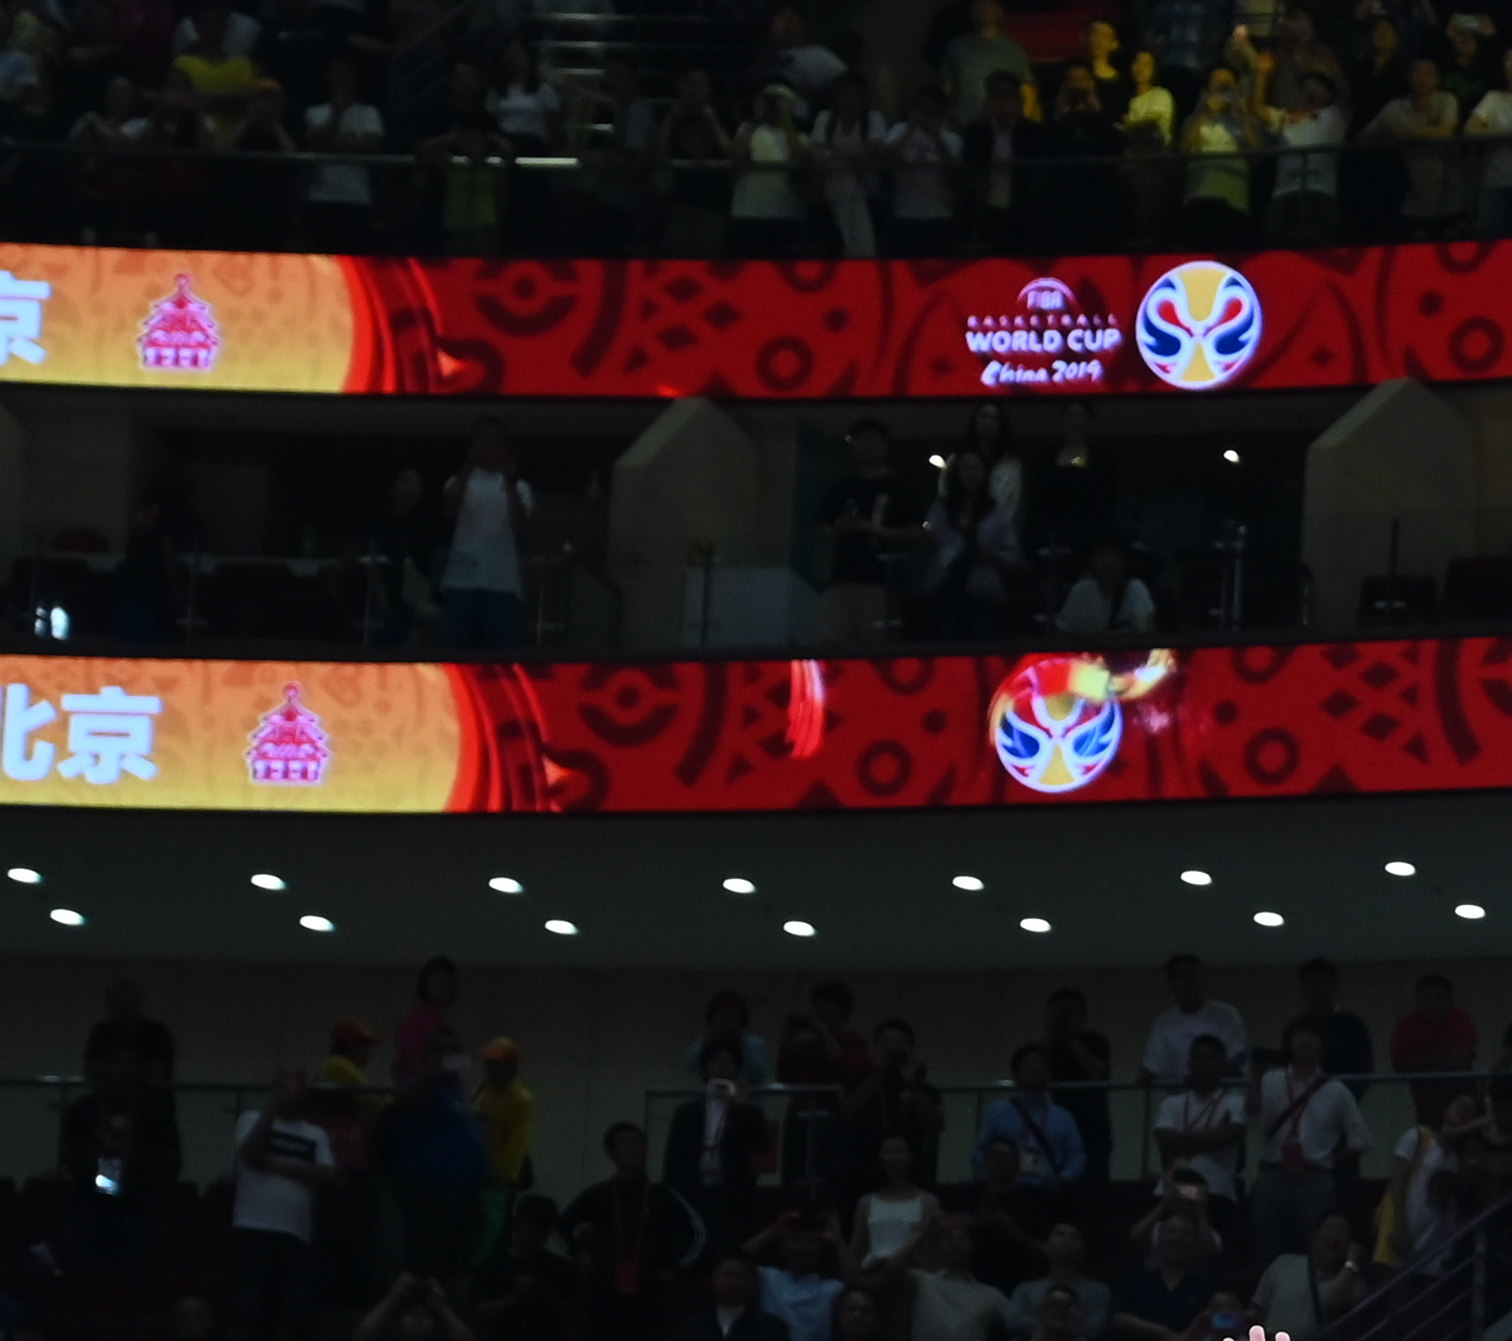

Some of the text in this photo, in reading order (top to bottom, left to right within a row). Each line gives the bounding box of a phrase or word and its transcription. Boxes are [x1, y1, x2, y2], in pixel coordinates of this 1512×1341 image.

[965, 328, 1123, 352] WORLD CUP
[981, 360, 1103, 386] China 2019
